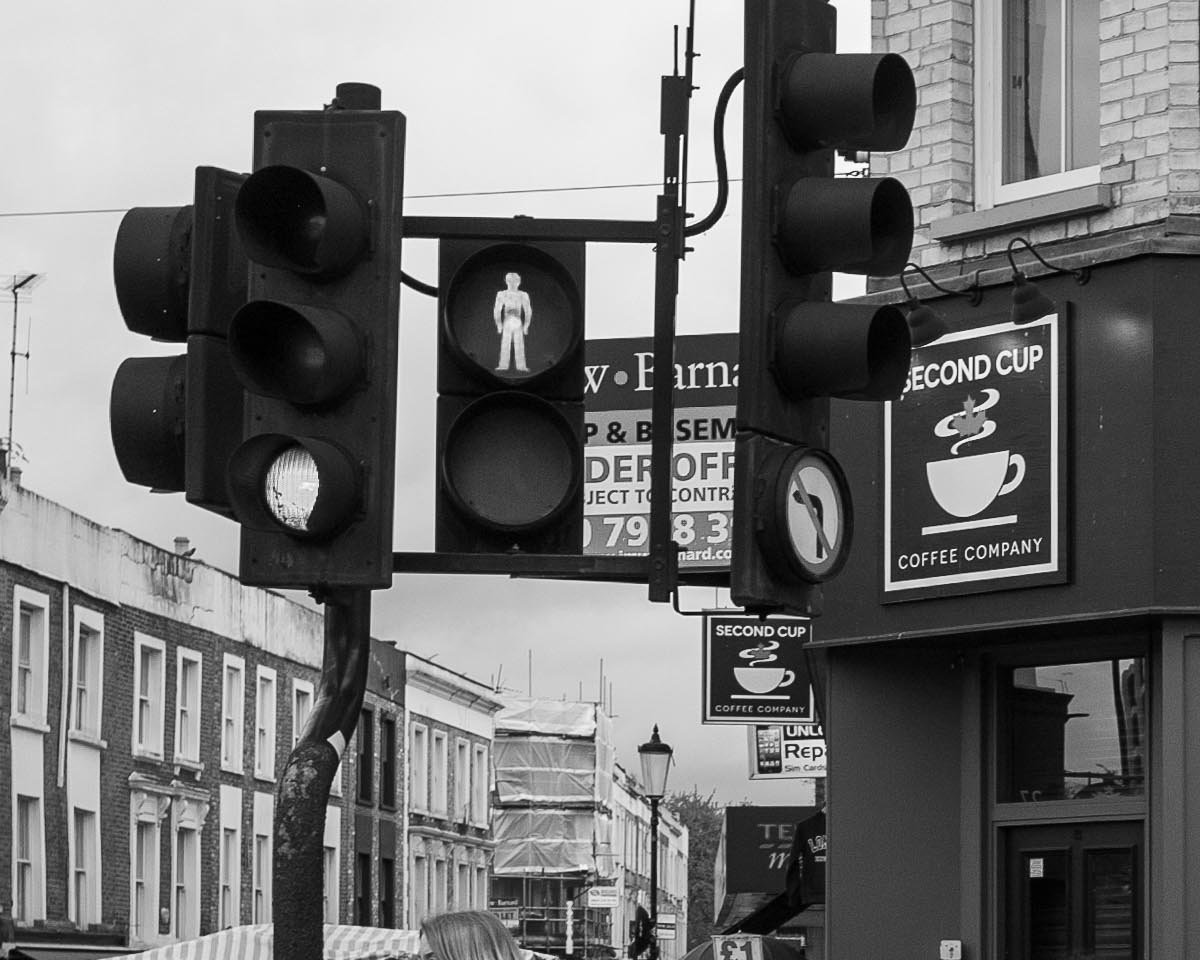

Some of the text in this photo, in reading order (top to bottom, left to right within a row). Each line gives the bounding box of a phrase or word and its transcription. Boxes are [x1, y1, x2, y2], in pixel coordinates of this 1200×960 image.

[995, 344, 1043, 376] CUP
[606, 421, 627, 443] &
[636, 417, 736, 443] BSEM
[898, 537, 1043, 570] COFFEE COMPANY
[715, 625, 806, 638] SECOND CUP
[757, 705, 806, 713] COMPANY
[785, 743, 827, 761] Rep
[785, 764, 801, 773] Sim
